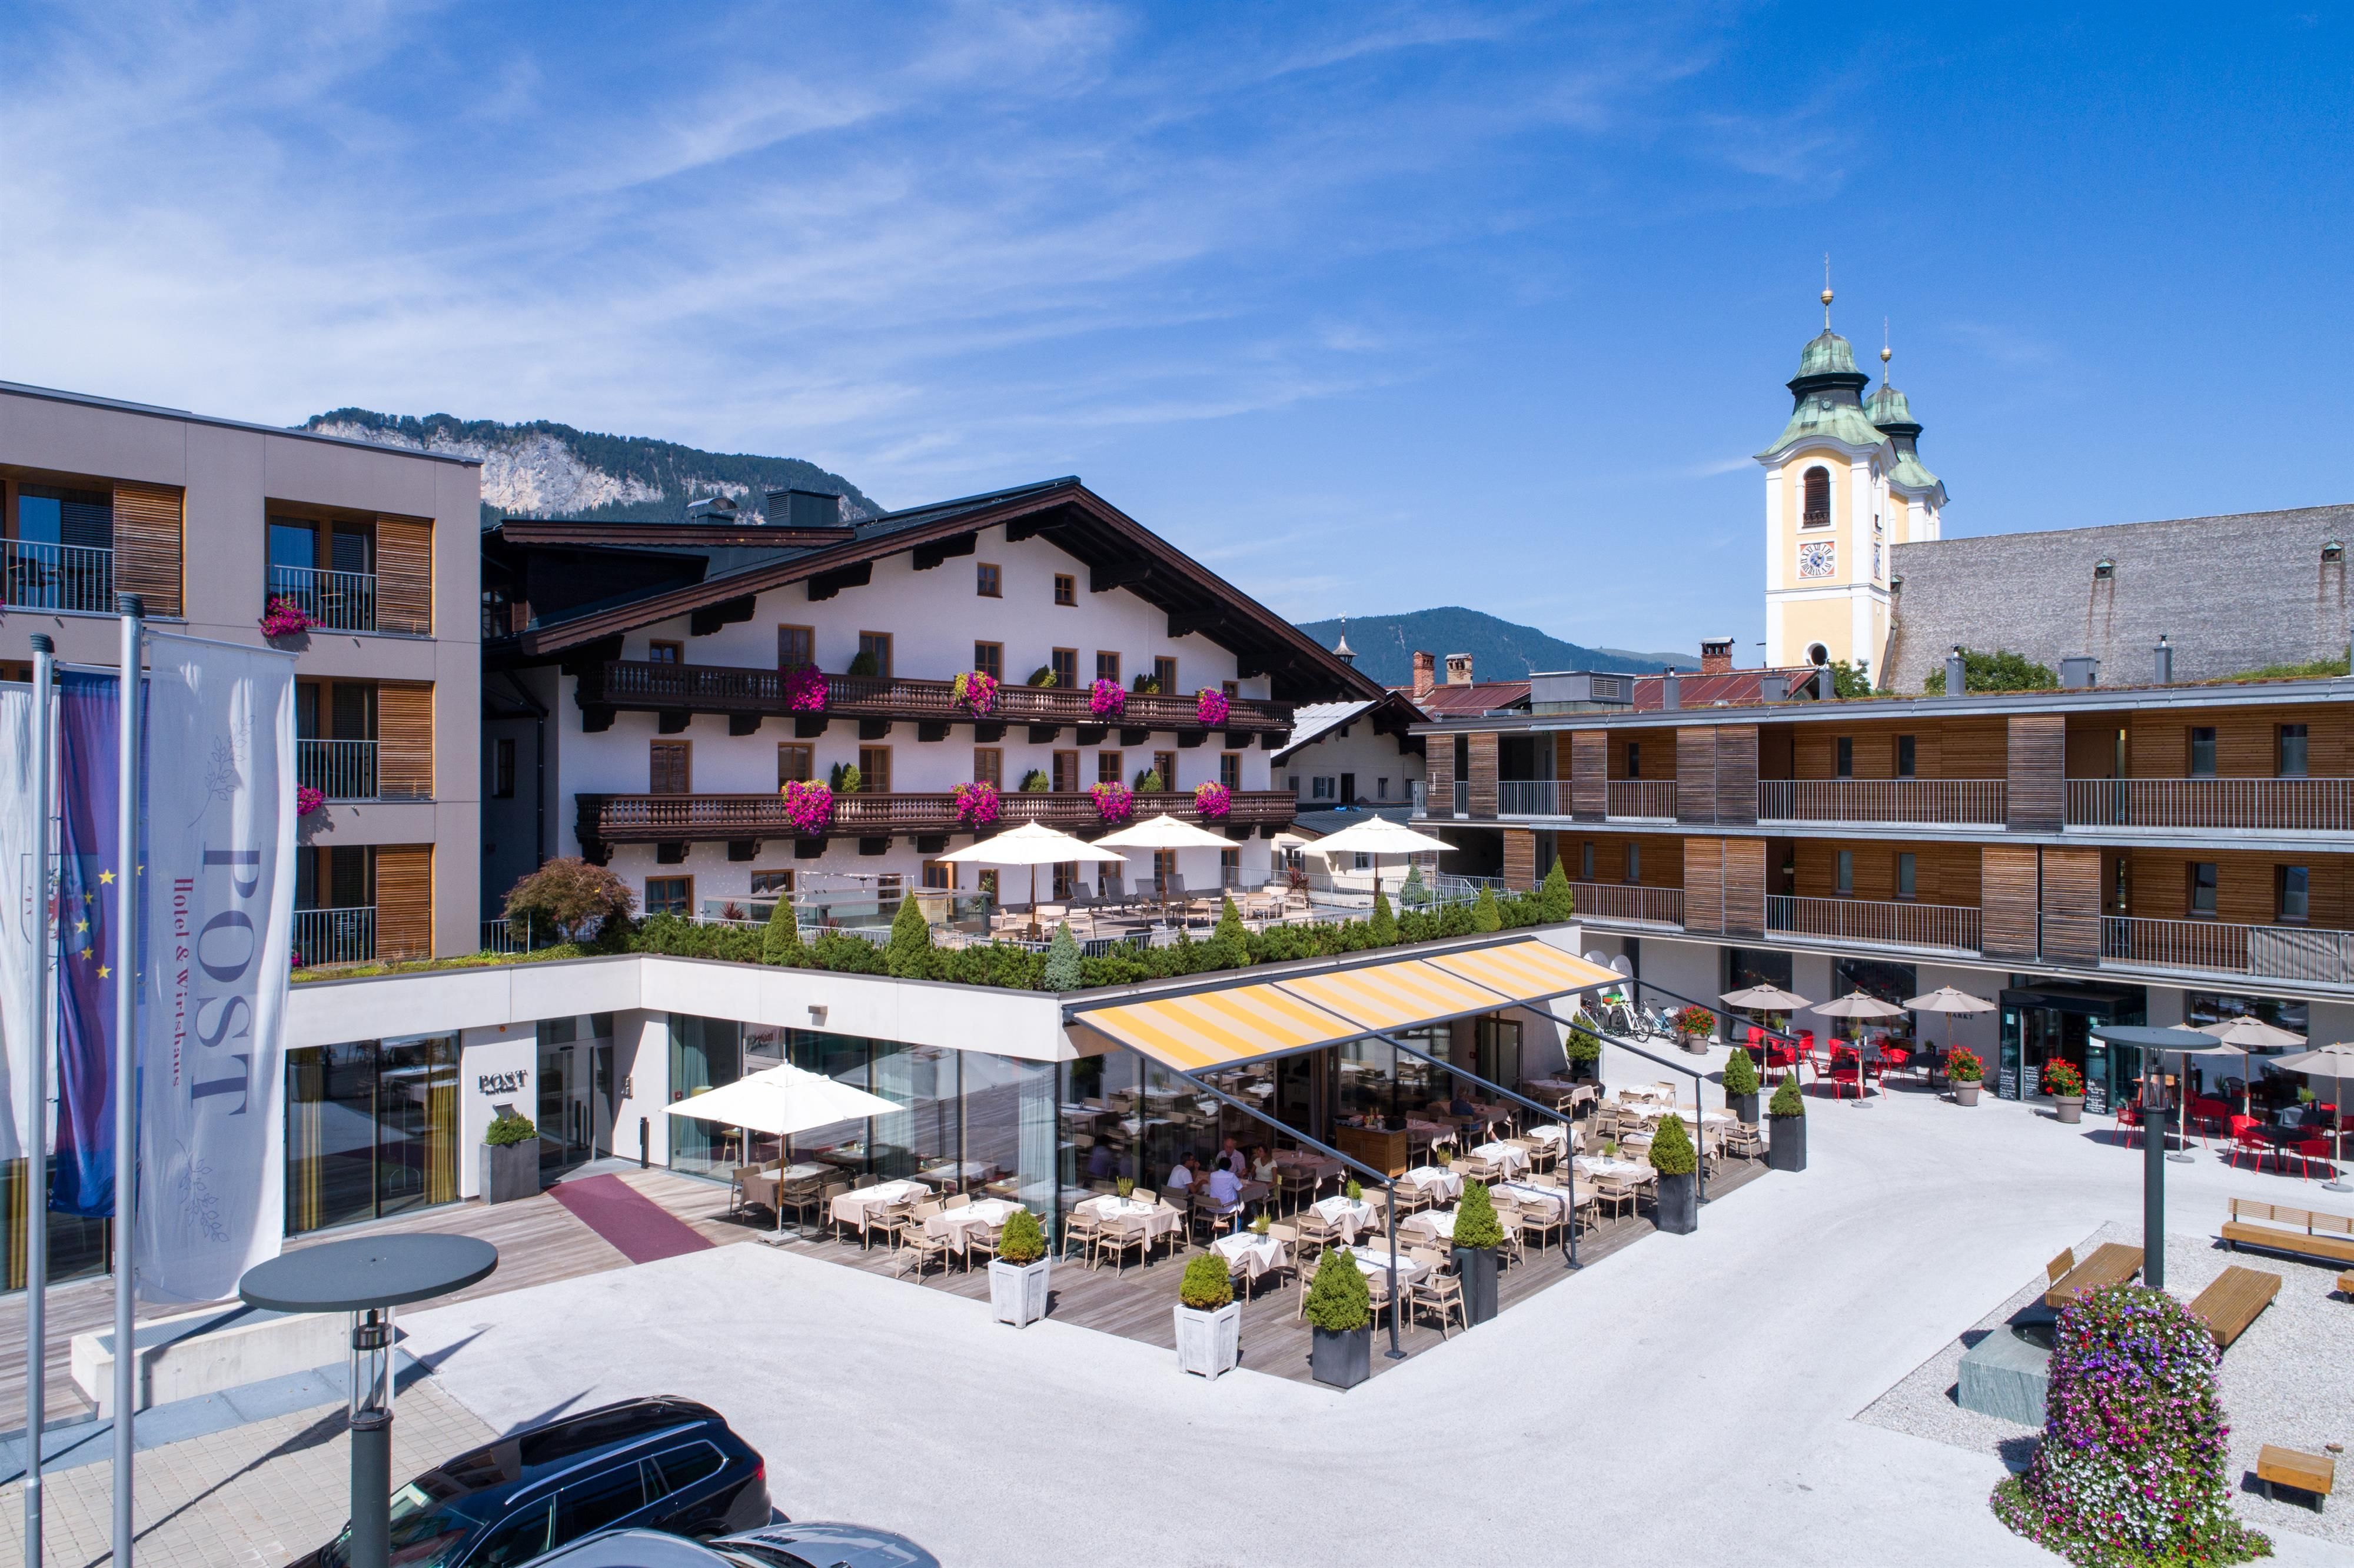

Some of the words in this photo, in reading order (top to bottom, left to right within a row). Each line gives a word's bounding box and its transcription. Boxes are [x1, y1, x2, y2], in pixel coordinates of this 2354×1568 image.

[174, 878, 194, 938] Hotel
[176, 944, 189, 961] &
[191, 841, 261, 1116] POST
[478, 1070, 527, 1090] POST
